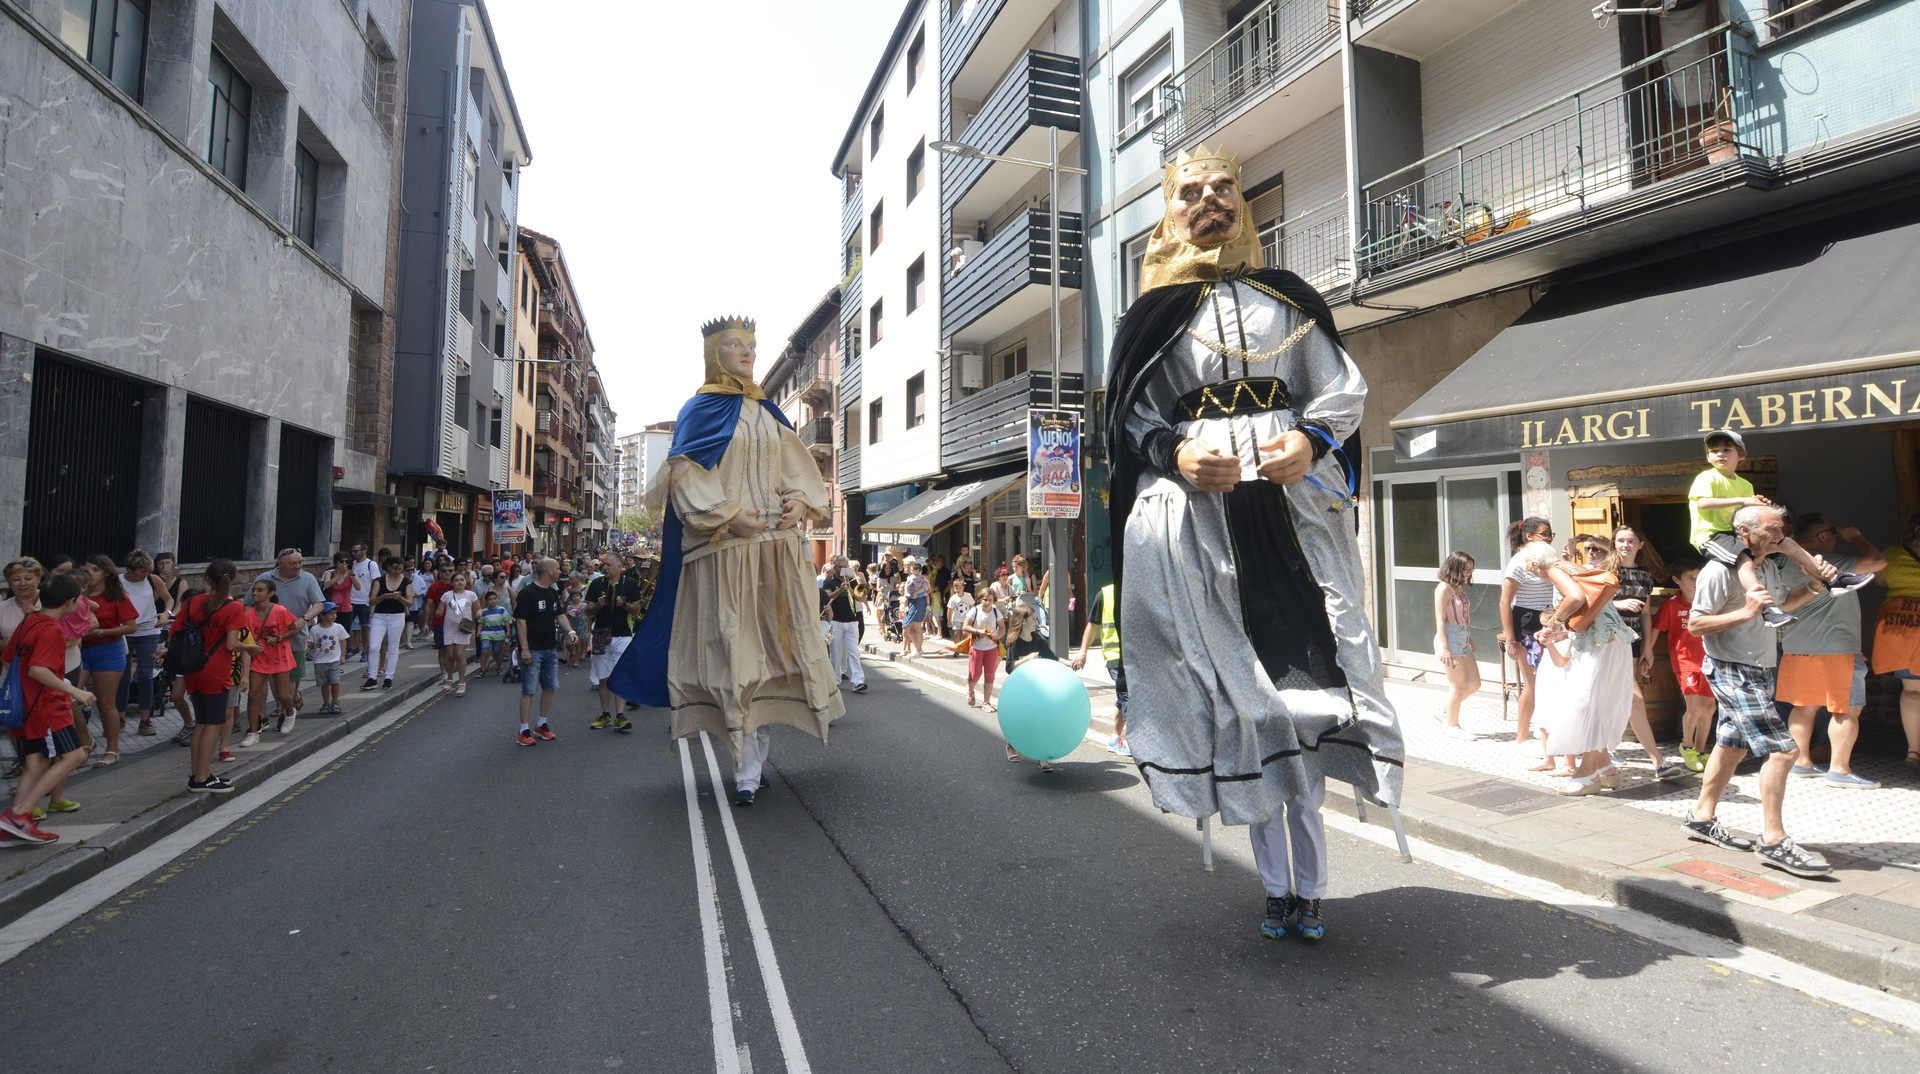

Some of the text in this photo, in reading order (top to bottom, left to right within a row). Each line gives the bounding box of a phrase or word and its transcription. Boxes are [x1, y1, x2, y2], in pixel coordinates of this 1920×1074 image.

[1520, 379, 1920, 449] ILARGI TABERN
[1038, 426, 1073, 447] SUEÑOS
[1041, 469, 1071, 487] BALA
[495, 498, 521, 512] SUEÑOS
